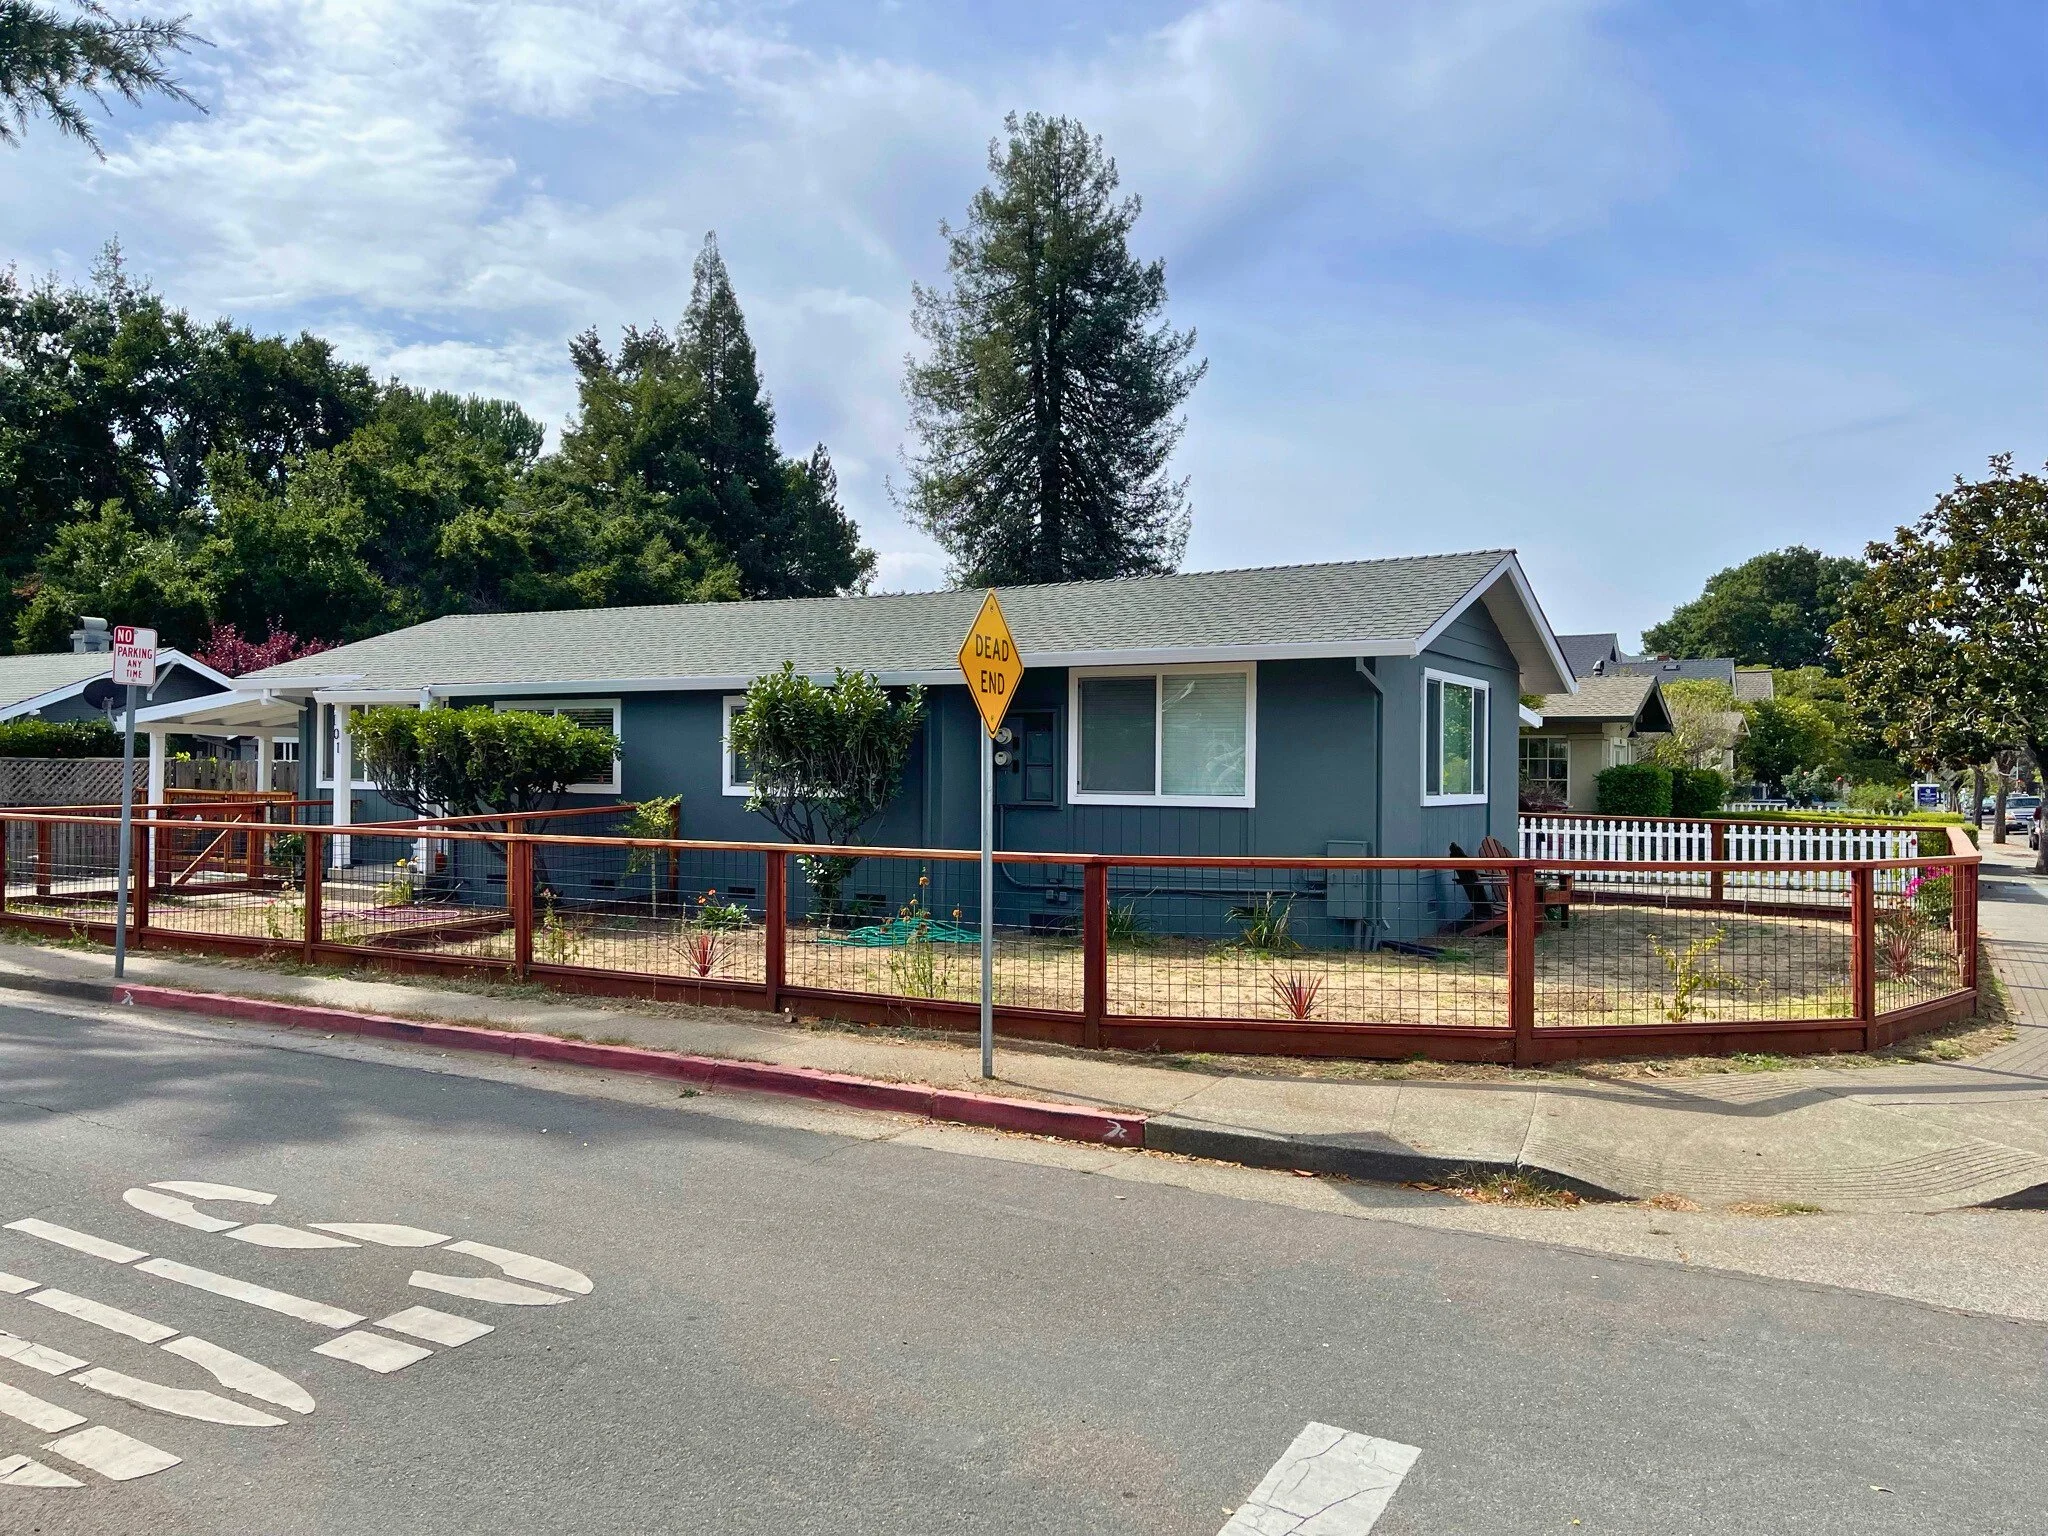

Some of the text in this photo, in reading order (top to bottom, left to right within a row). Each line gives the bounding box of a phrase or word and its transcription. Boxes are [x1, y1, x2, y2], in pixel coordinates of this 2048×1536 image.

[118, 629, 132, 643] NO
[117, 646, 153, 659] PARKING
[975, 634, 1009, 662] DEAD
[127, 660, 142, 668] ANY
[126, 670, 142, 678] TIME
[980, 670, 1005, 695] END
